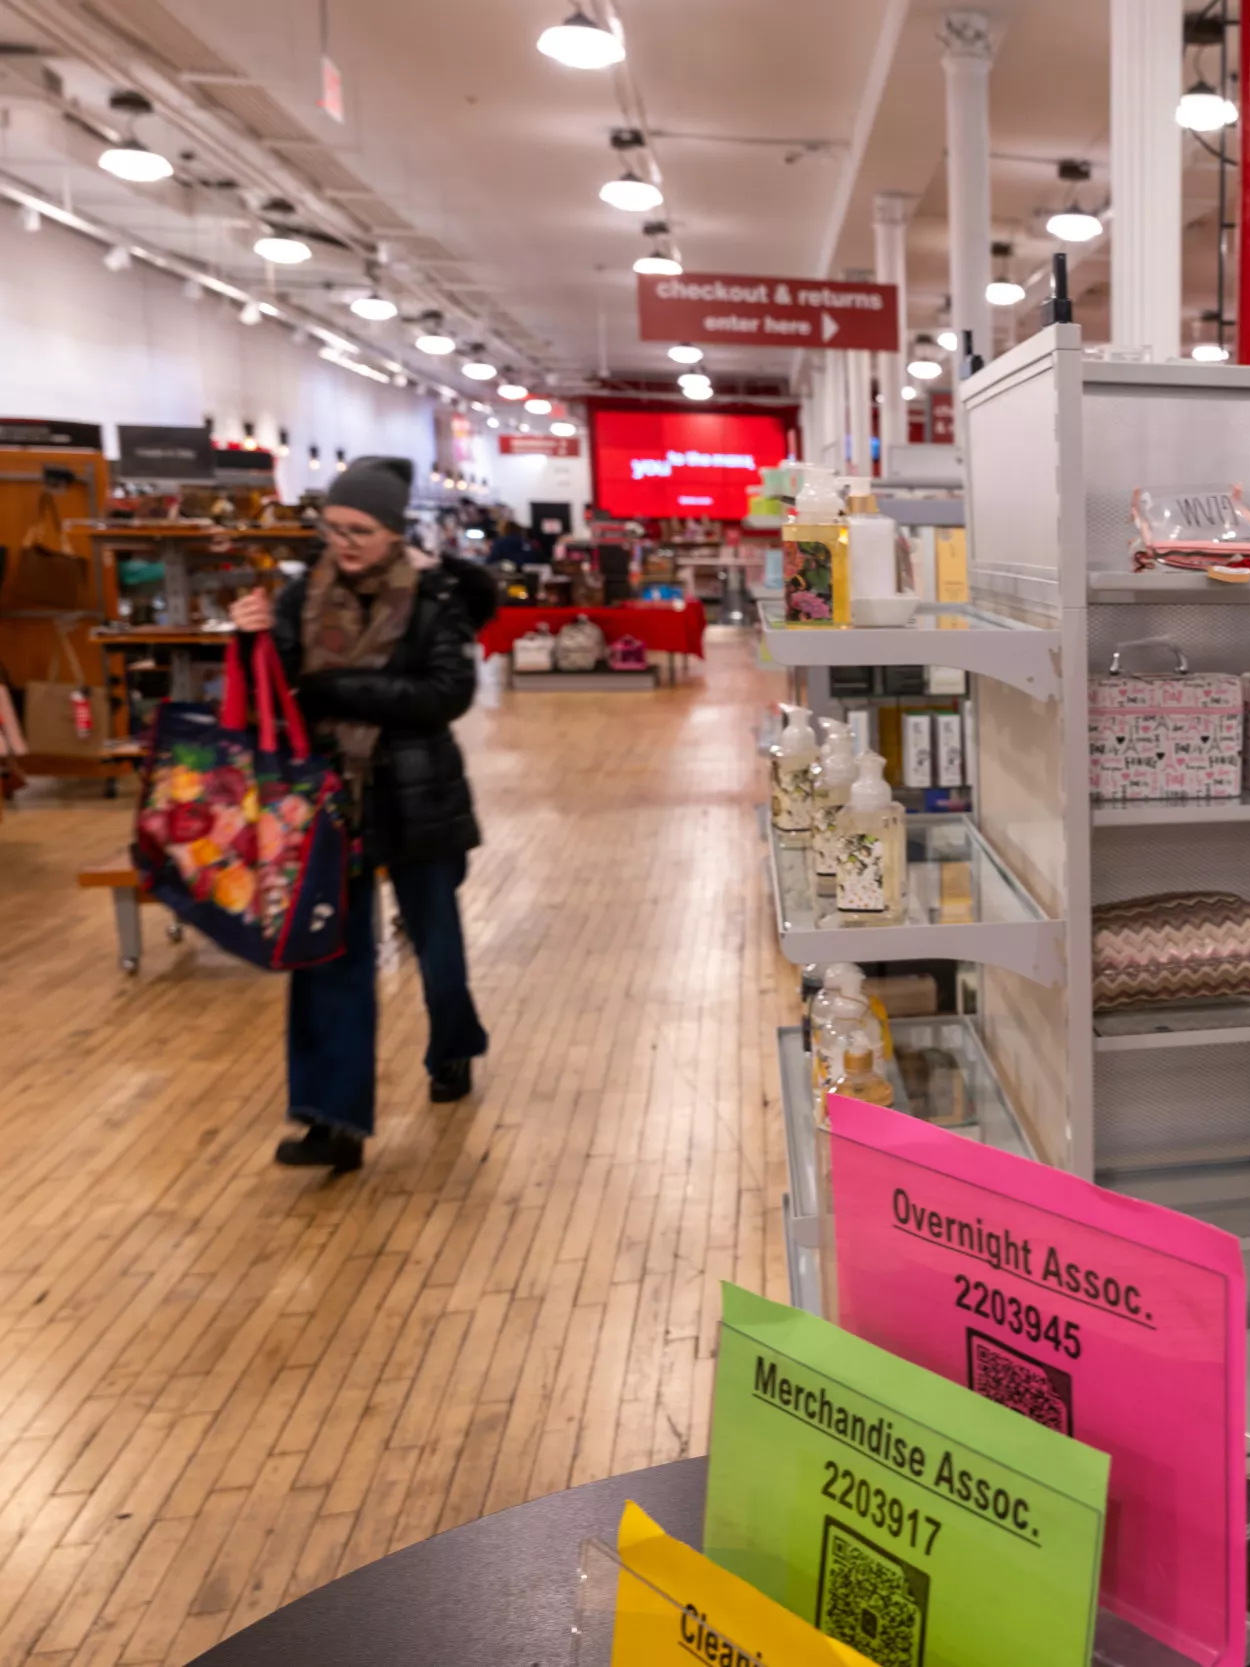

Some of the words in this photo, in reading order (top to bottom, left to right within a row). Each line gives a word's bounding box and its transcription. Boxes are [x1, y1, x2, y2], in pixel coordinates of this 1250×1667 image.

[656, 280, 769, 304] checkout
[773, 283, 792, 305] &
[797, 288, 883, 310] returns
[704, 314, 760, 332] enter
[763, 315, 812, 336] here
[892, 1188, 1031, 1276] Overnight
[1042, 1246, 1153, 1321] Assoc.
[954, 1274, 1081, 1360] 2203945
[754, 1356, 925, 1478] Merchandise
[934, 1450, 1041, 1538] Assoc.
[820, 1460, 941, 1555] 2203917
